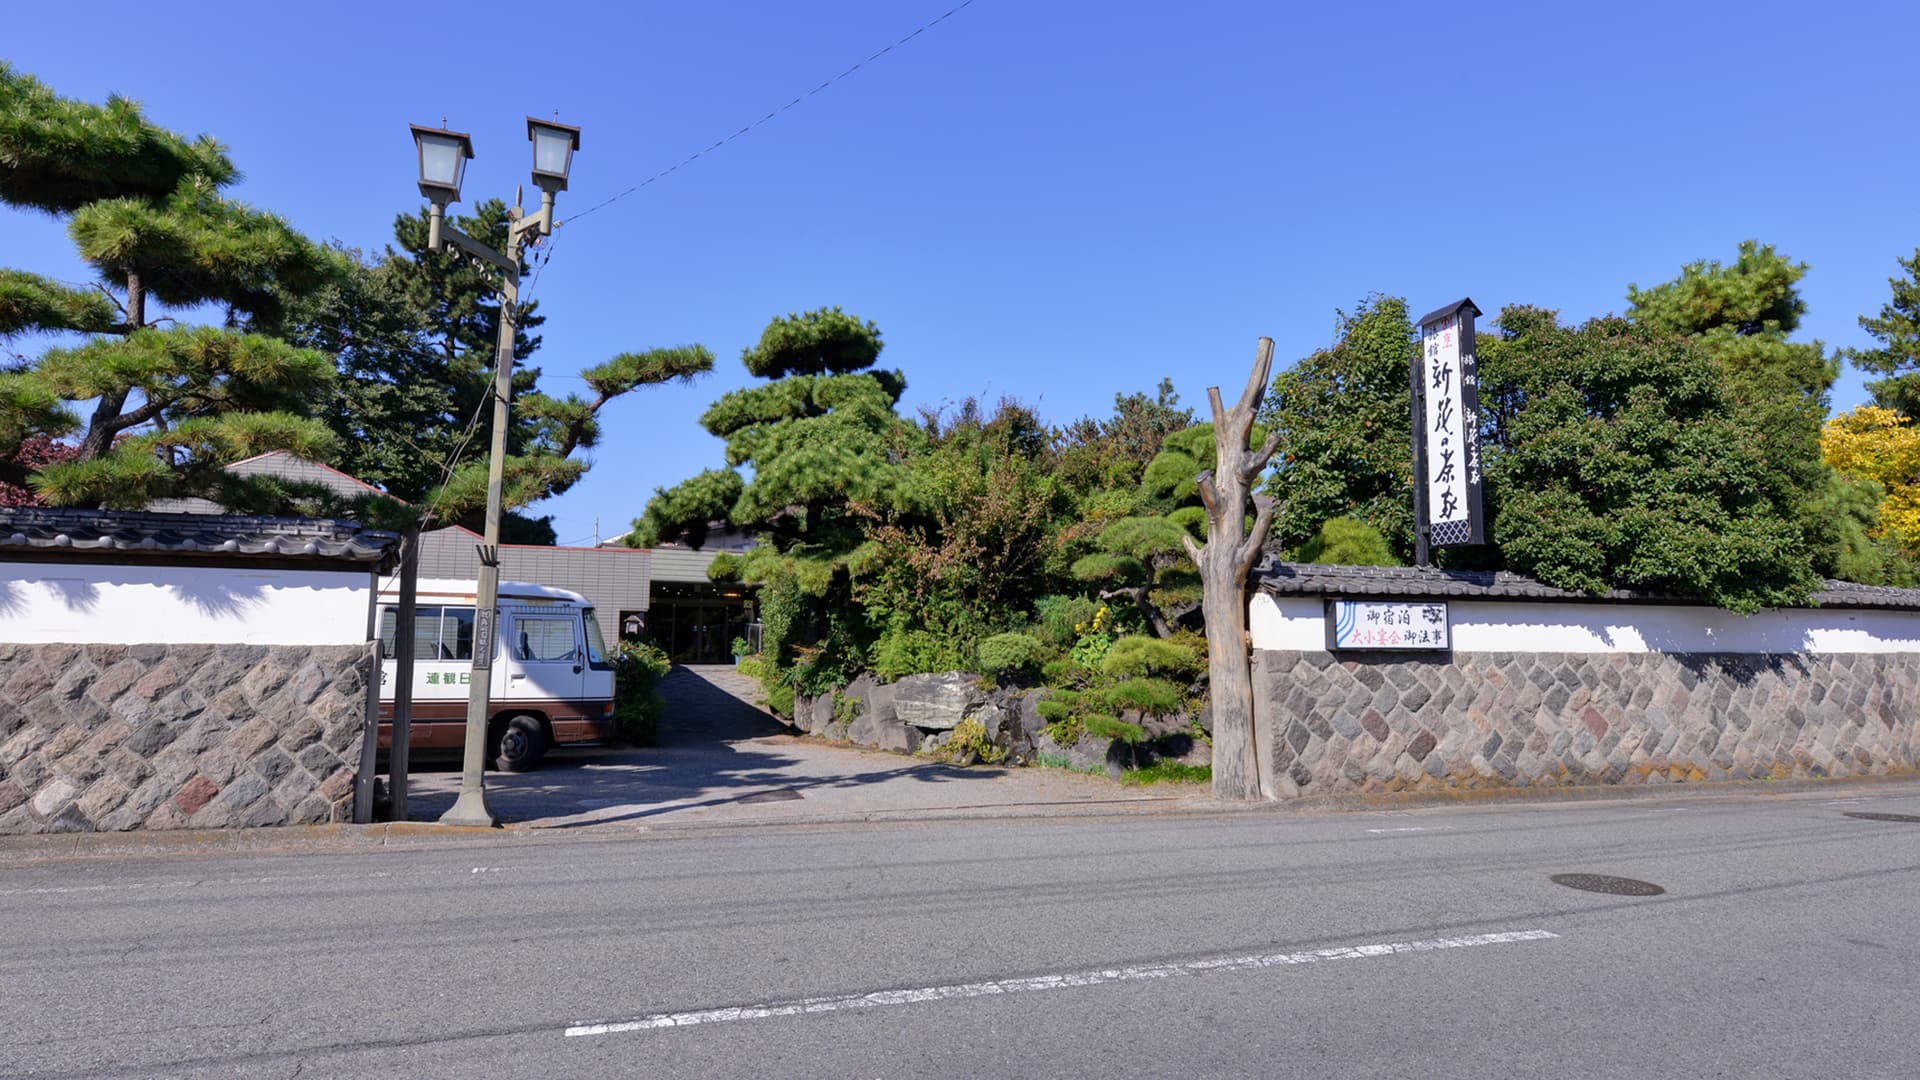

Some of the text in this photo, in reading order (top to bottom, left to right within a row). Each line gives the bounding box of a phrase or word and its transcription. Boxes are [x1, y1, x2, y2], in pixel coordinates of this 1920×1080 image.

[1428, 325, 1440, 358] 旅館
[1463, 354, 1476, 385] 旅館
[1366, 609, 1411, 626] 御宿泊
[1403, 629, 1443, 645] 御法事
